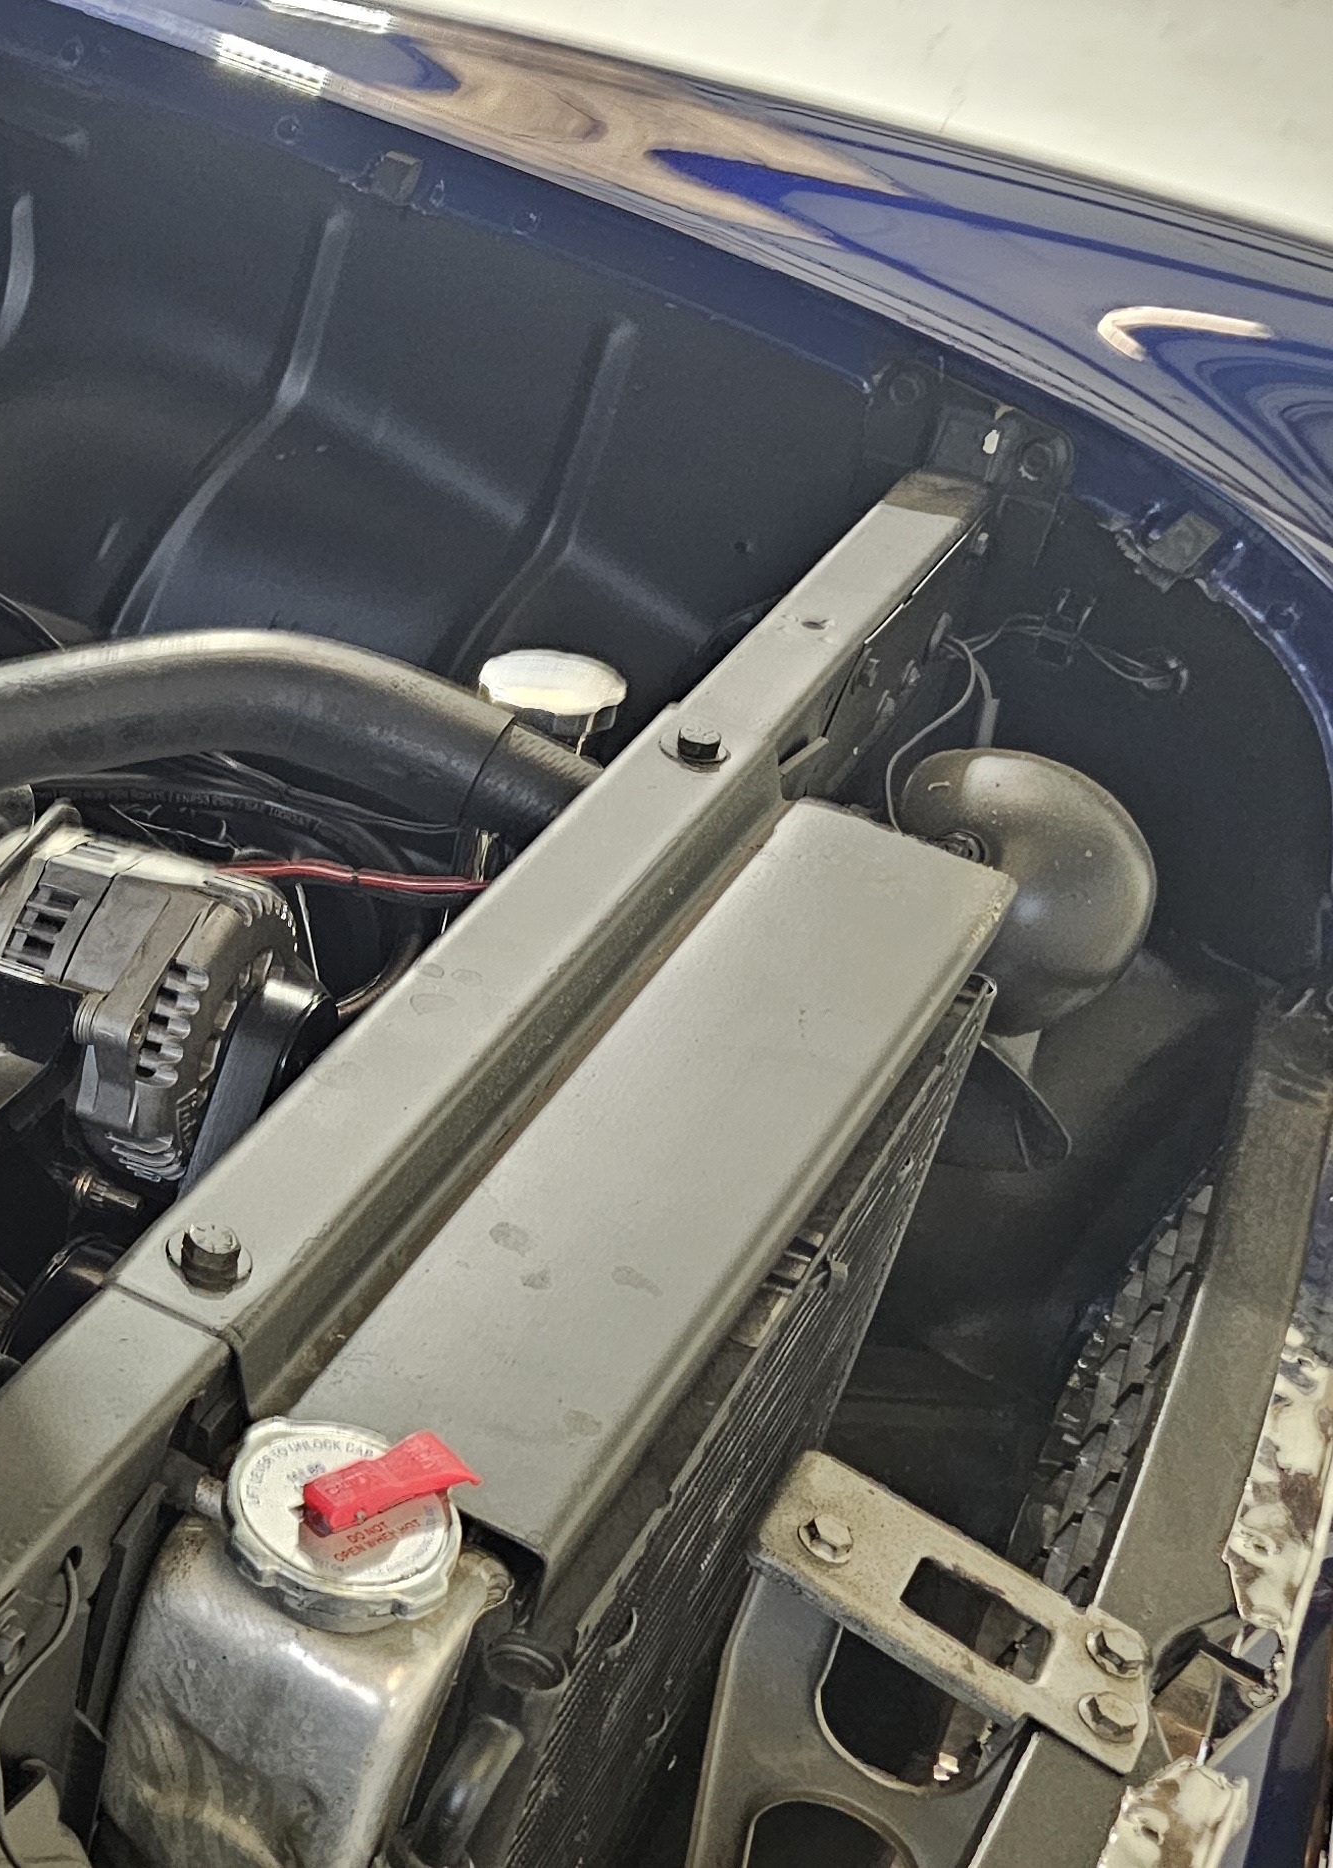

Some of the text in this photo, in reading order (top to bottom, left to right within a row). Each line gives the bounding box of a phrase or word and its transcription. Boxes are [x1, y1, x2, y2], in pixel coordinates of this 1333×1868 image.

[287, 1438, 341, 1454] UNLOCK
[334, 1544, 367, 1562] OPEN
[367, 1530, 398, 1549] WHEN
[396, 1518, 422, 1535] HOT
[346, 1521, 390, 1544] DO NOT
